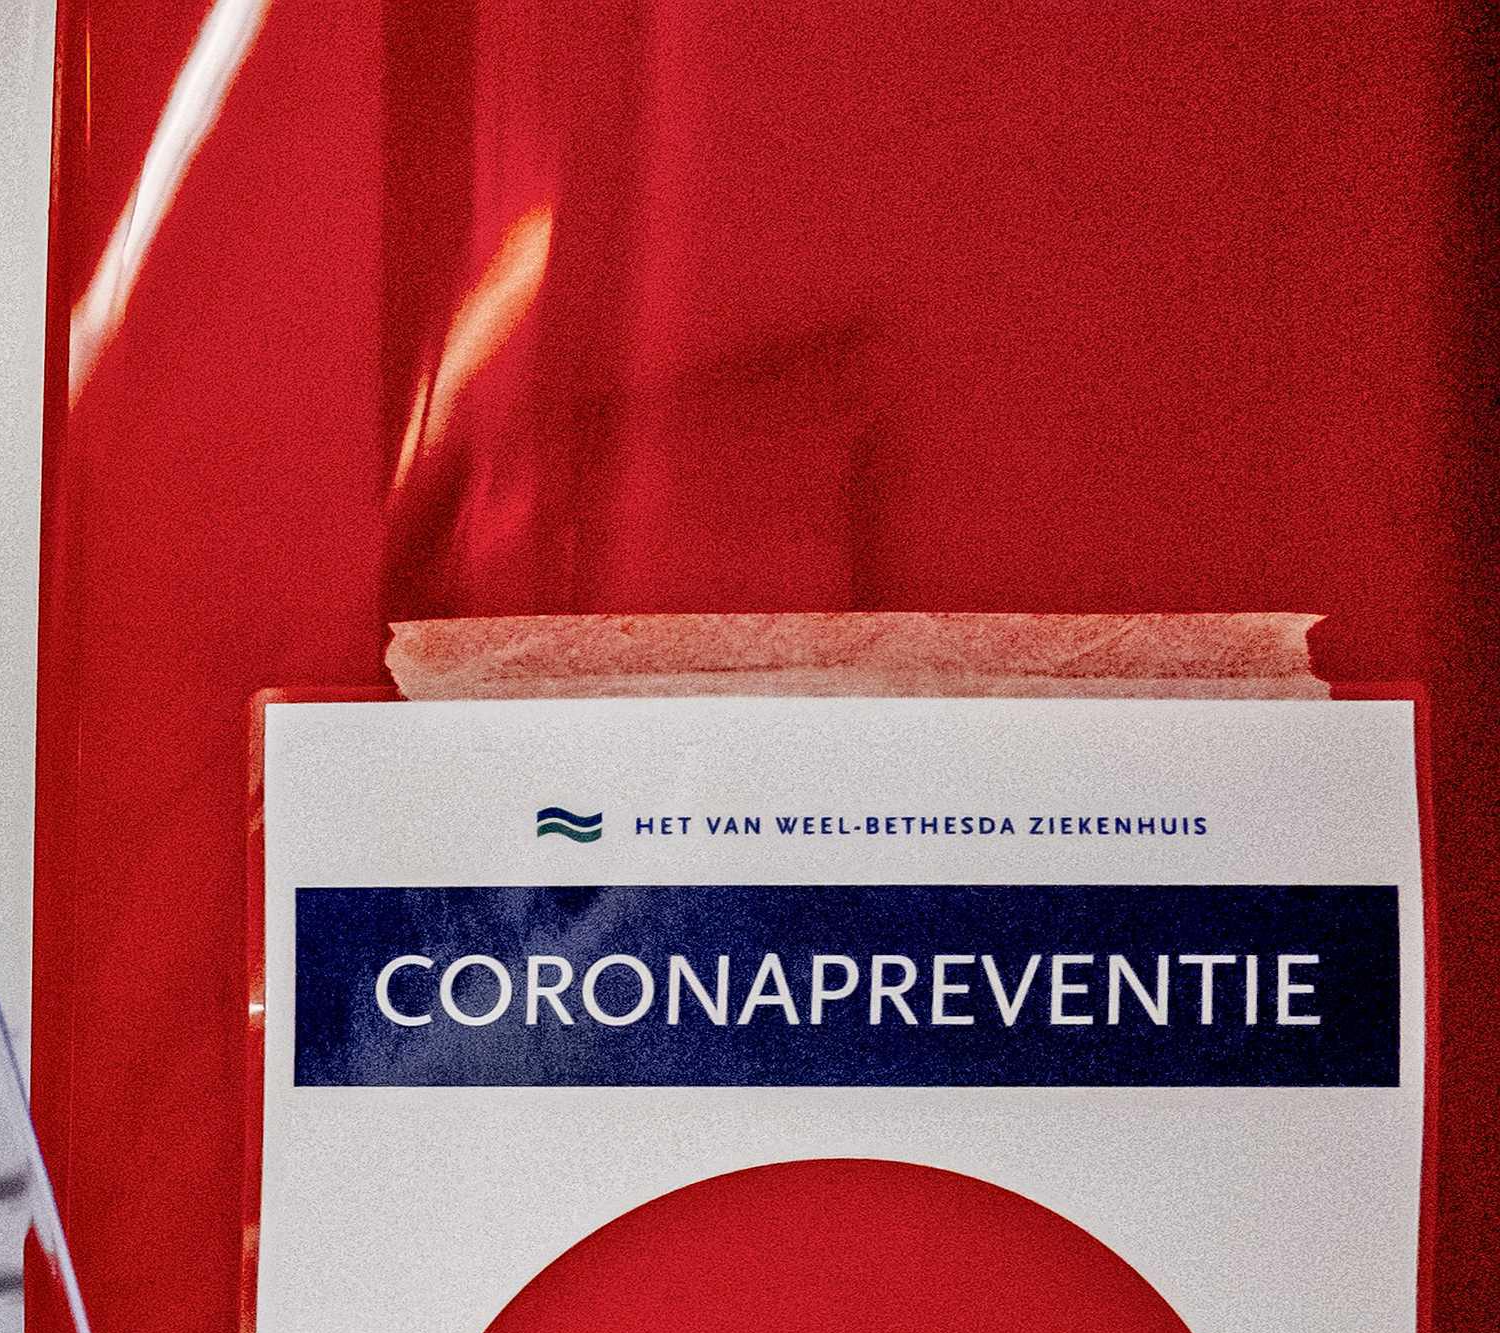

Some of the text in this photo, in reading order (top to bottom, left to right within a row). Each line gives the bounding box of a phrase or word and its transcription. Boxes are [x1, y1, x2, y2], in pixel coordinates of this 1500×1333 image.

[634, 815, 1208, 837] HET VAN WEEL-BETHESDA ZIEKENHUIS
[375, 953, 1319, 1028] CORONAPREVENTIE
